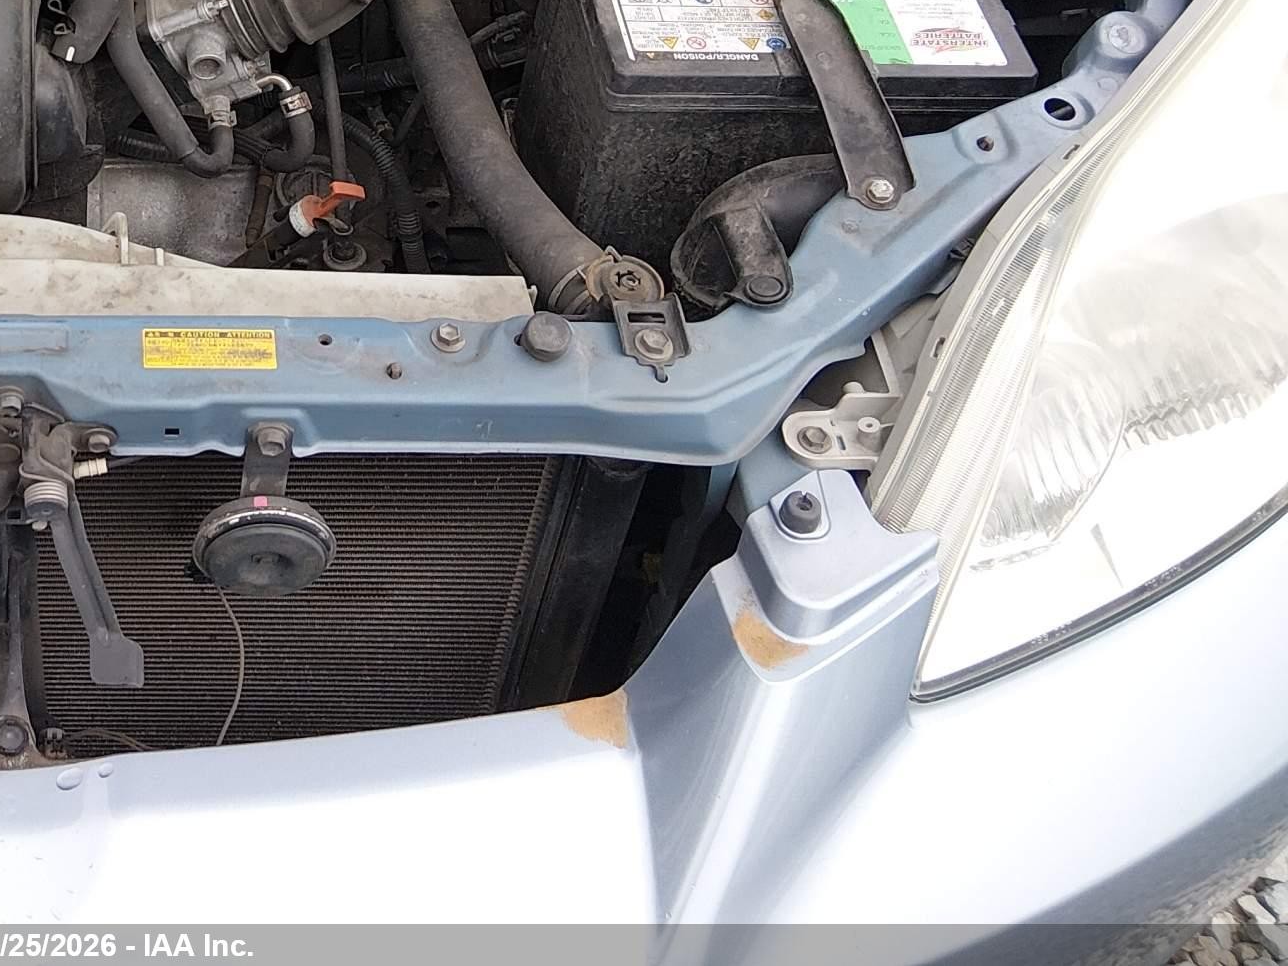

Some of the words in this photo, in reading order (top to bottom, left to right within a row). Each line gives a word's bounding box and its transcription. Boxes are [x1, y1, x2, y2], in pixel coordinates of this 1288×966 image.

[914, 32, 983, 40] BATTERIES
[911, 39, 987, 48] INTERSTATE
[673, 52, 759, 61] DANGER/POISON
[227, 331, 271, 339] ATTENTION
